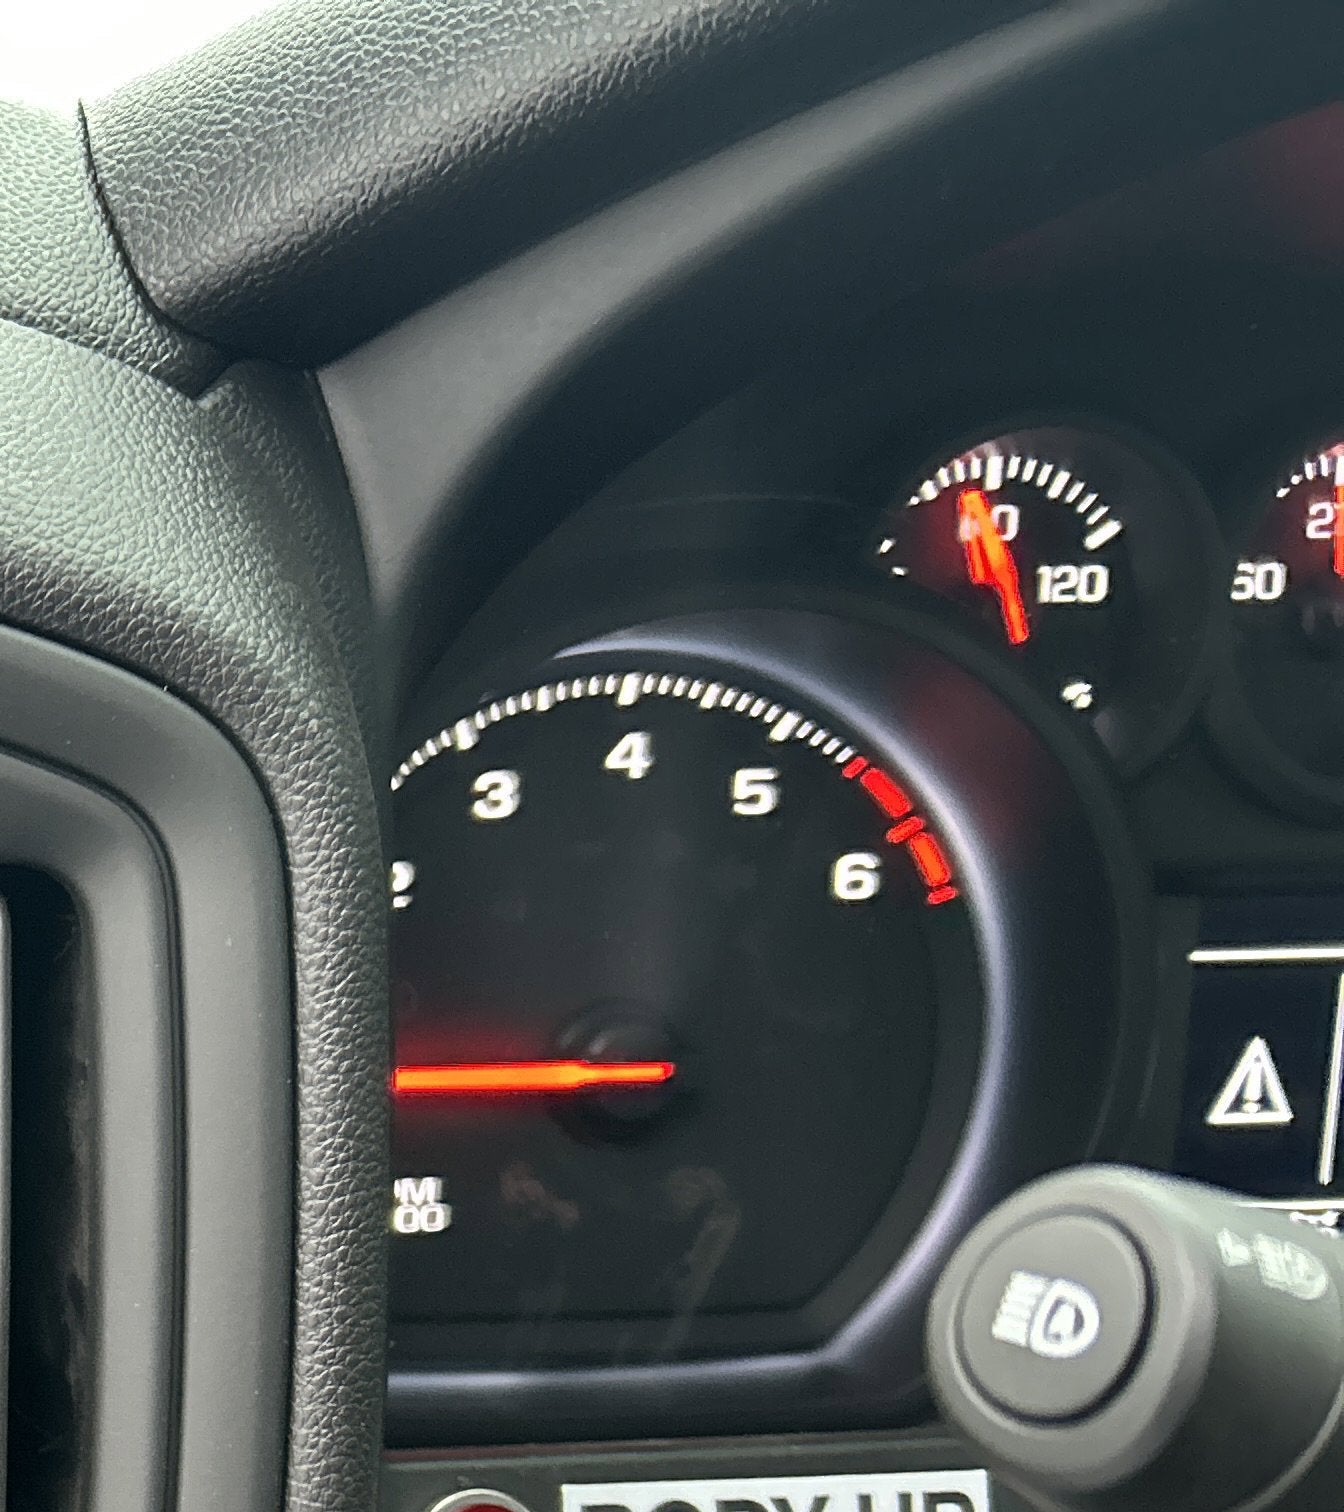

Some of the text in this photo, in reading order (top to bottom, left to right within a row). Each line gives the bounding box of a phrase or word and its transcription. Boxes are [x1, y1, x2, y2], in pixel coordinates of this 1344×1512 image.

[960, 504, 1020, 542] 0
[1036, 564, 1109, 603] 120
[604, 731, 653, 779] 4
[471, 769, 520, 820] 3
[732, 767, 778, 816] 5
[833, 852, 880, 900] 6
